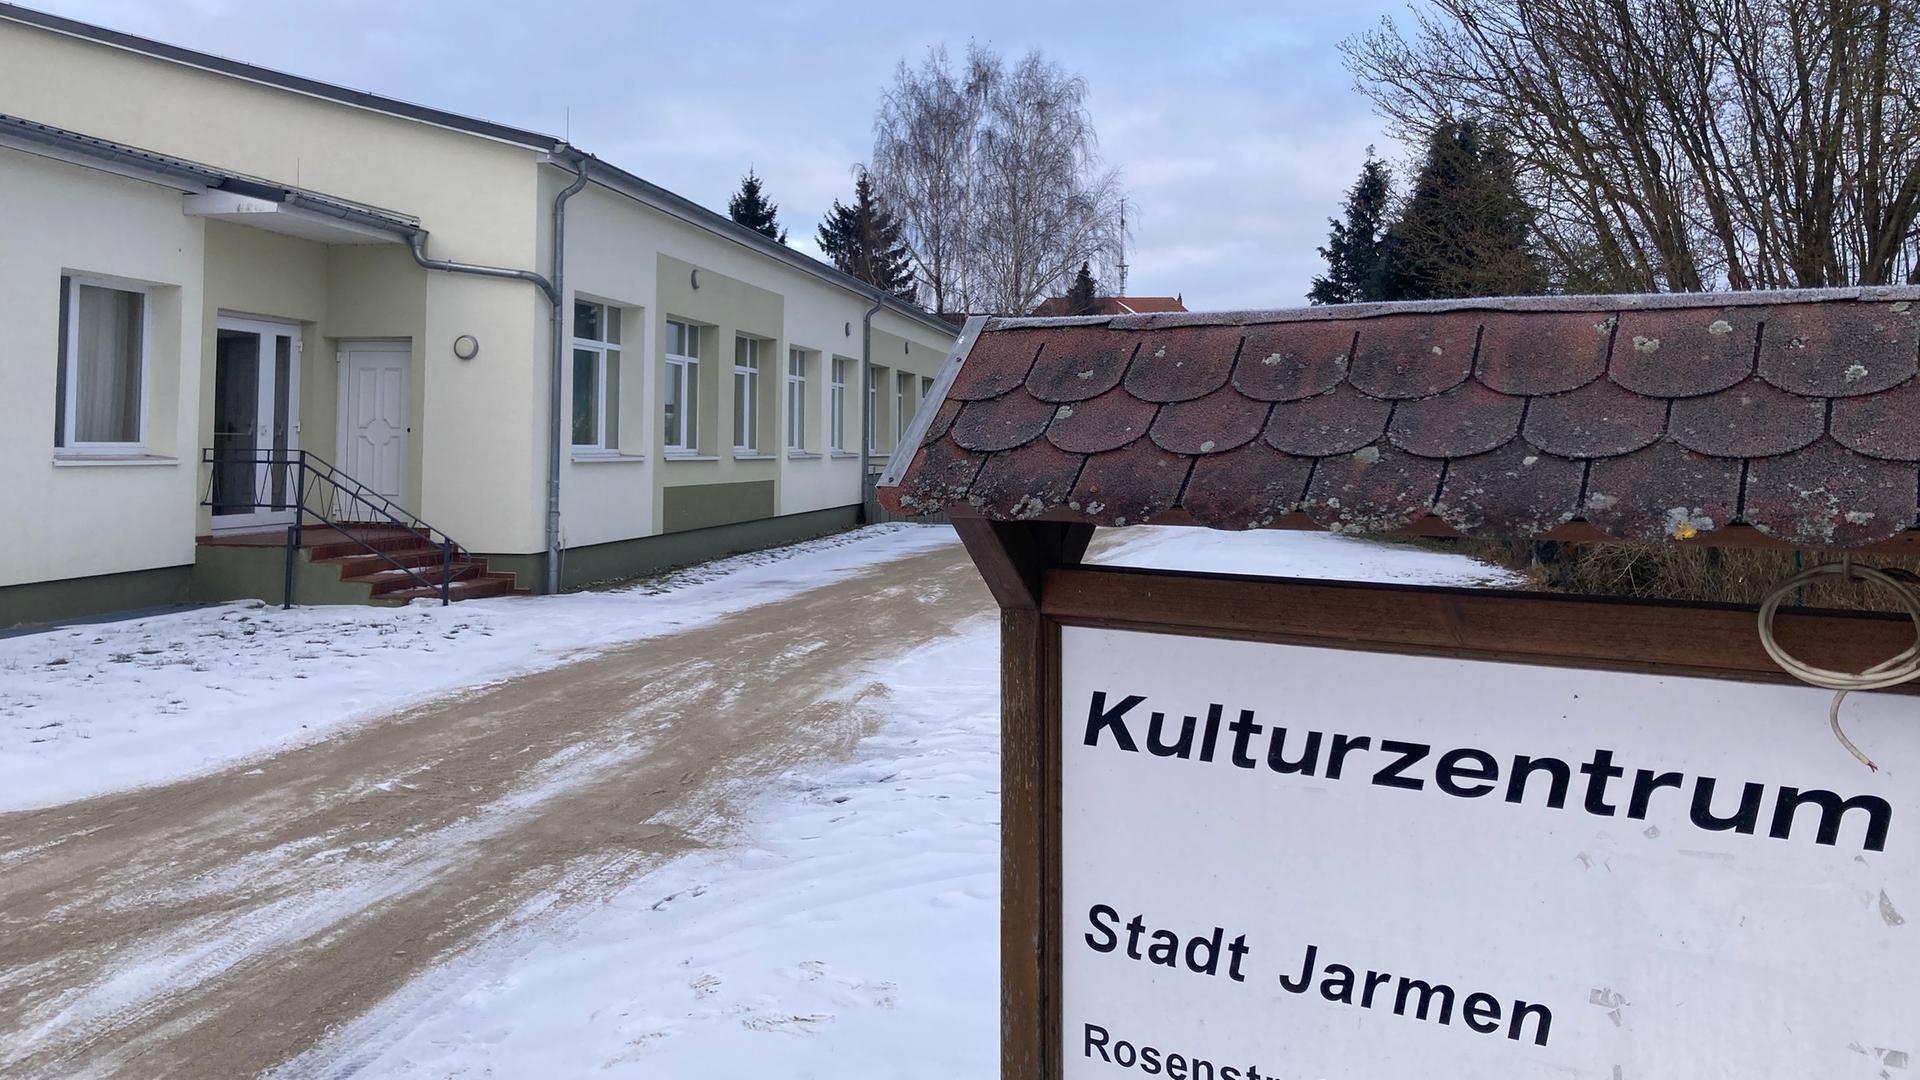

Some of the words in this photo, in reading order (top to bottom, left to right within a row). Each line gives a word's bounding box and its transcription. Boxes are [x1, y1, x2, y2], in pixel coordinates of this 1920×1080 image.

[1084, 690, 1892, 852] Kulturzentrum
[1085, 904, 1250, 983] Stadt
[1280, 944, 1553, 1047] Jarmen
[1085, 1023, 1281, 1080] Rosens
